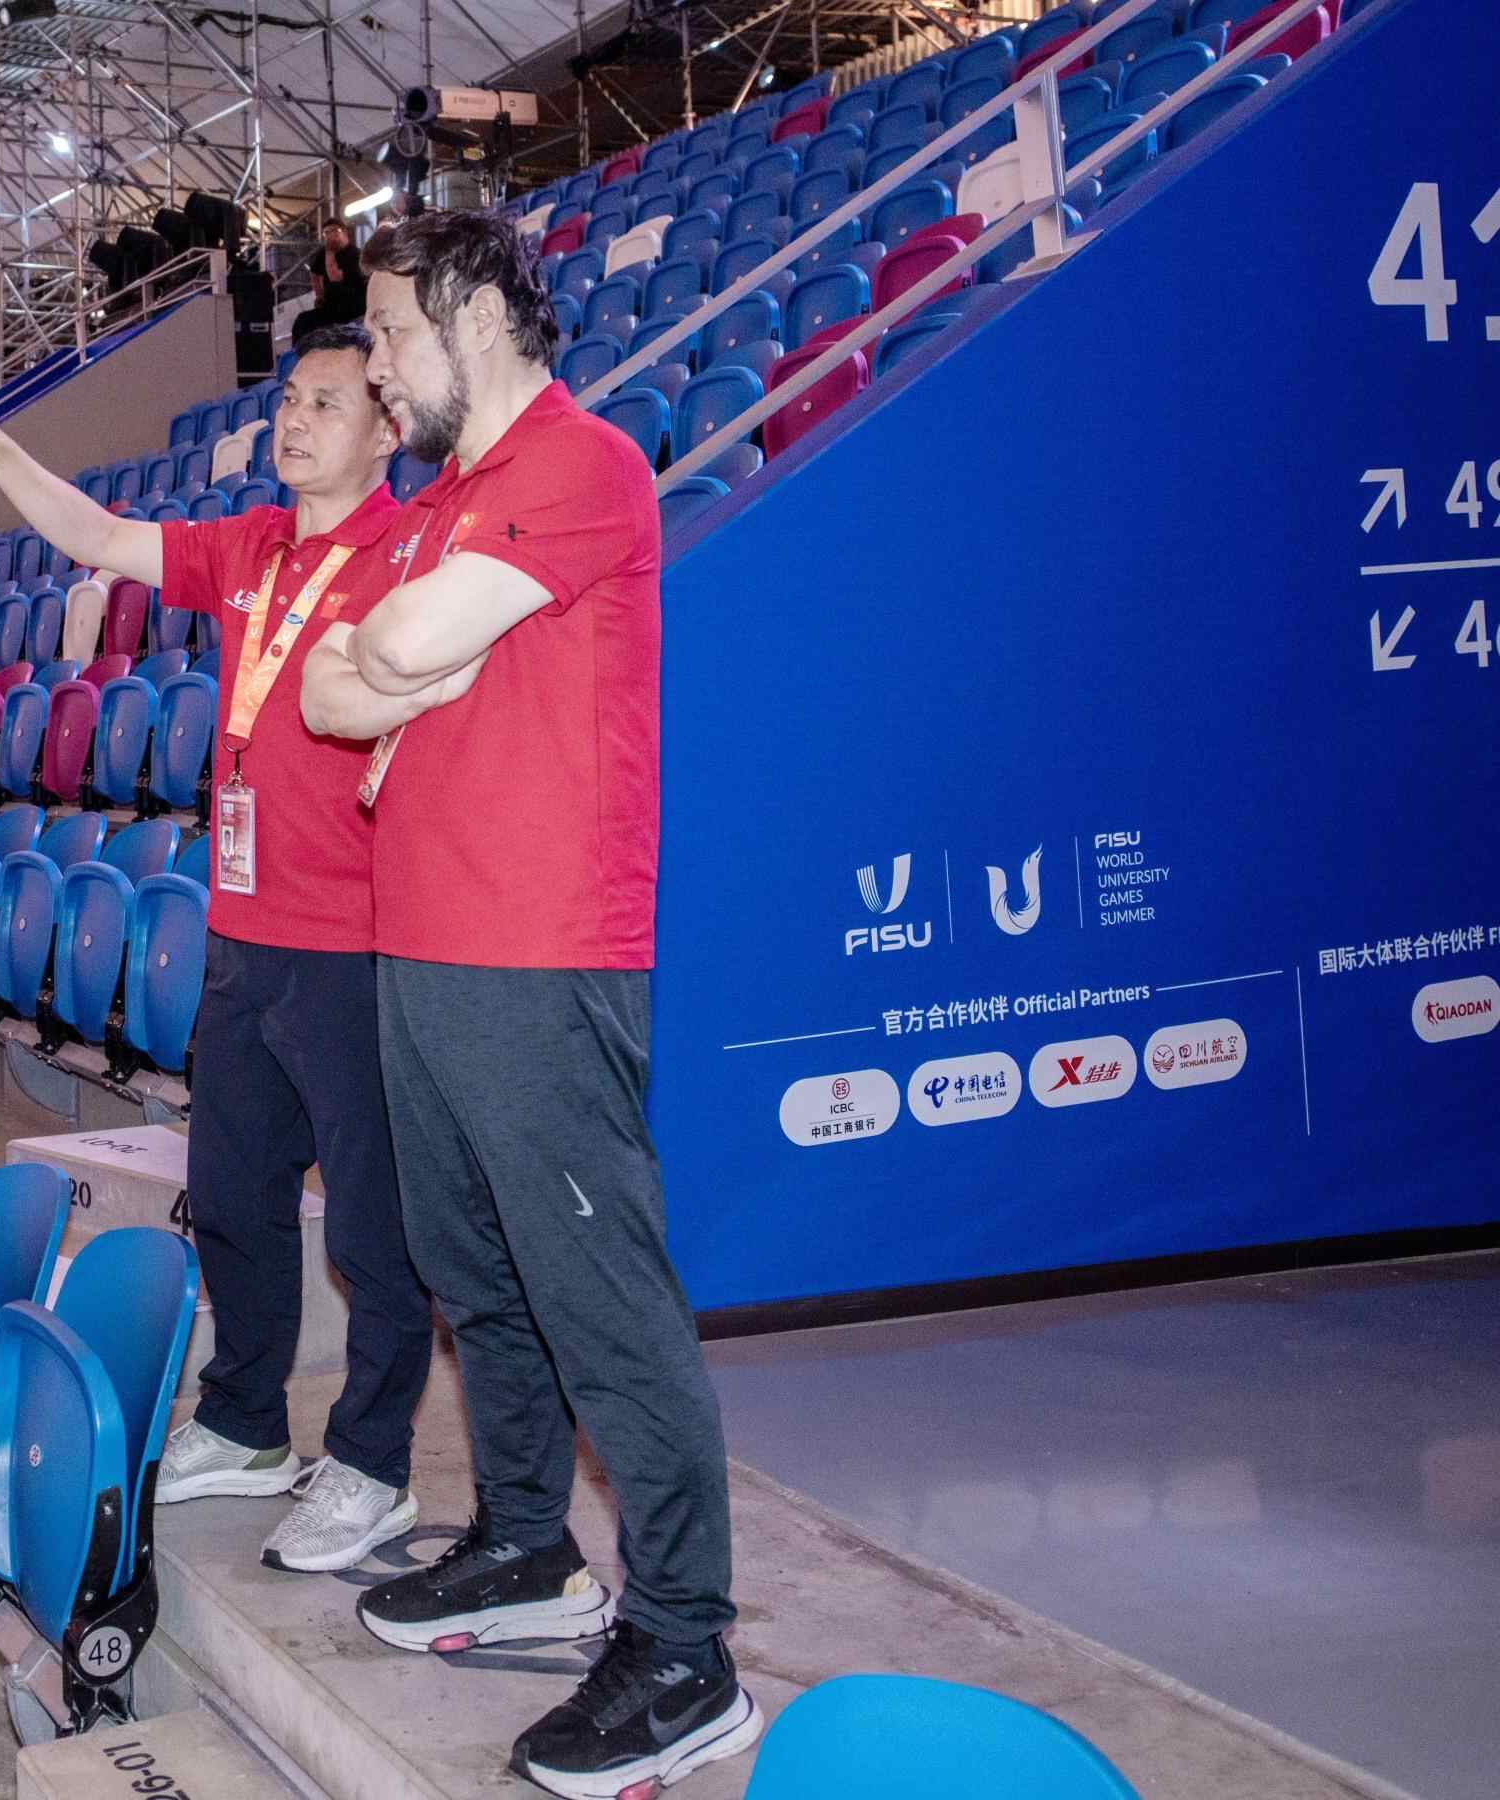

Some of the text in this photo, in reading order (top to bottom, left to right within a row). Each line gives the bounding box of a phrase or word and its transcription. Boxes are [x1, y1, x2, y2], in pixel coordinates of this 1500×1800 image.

[1454, 600, 1500, 668] 4
[1095, 830, 1141, 849] FISU
[1096, 851, 1144, 869] WORLD
[1098, 867, 1171, 888] UNIVERSITY
[1099, 889, 1143, 907] GAMES
[1100, 906, 1156, 926] SUMMER
[845, 921, 932, 955] FISU
[1319, 925, 1485, 975] 国际大体联合作伙伴
[882, 985, 1150, 1036] 官方合作伙伴 Official Partners
[1436, 998, 1492, 1020] QIAODAN
[954, 1070, 1006, 1095] 中国电信
[955, 1090, 1008, 1104] CHINA TELECOM
[830, 1102, 855, 1115] ICBC
[811, 1117, 876, 1139] 中国工商银行
[88, 1636, 122, 1666] 48
